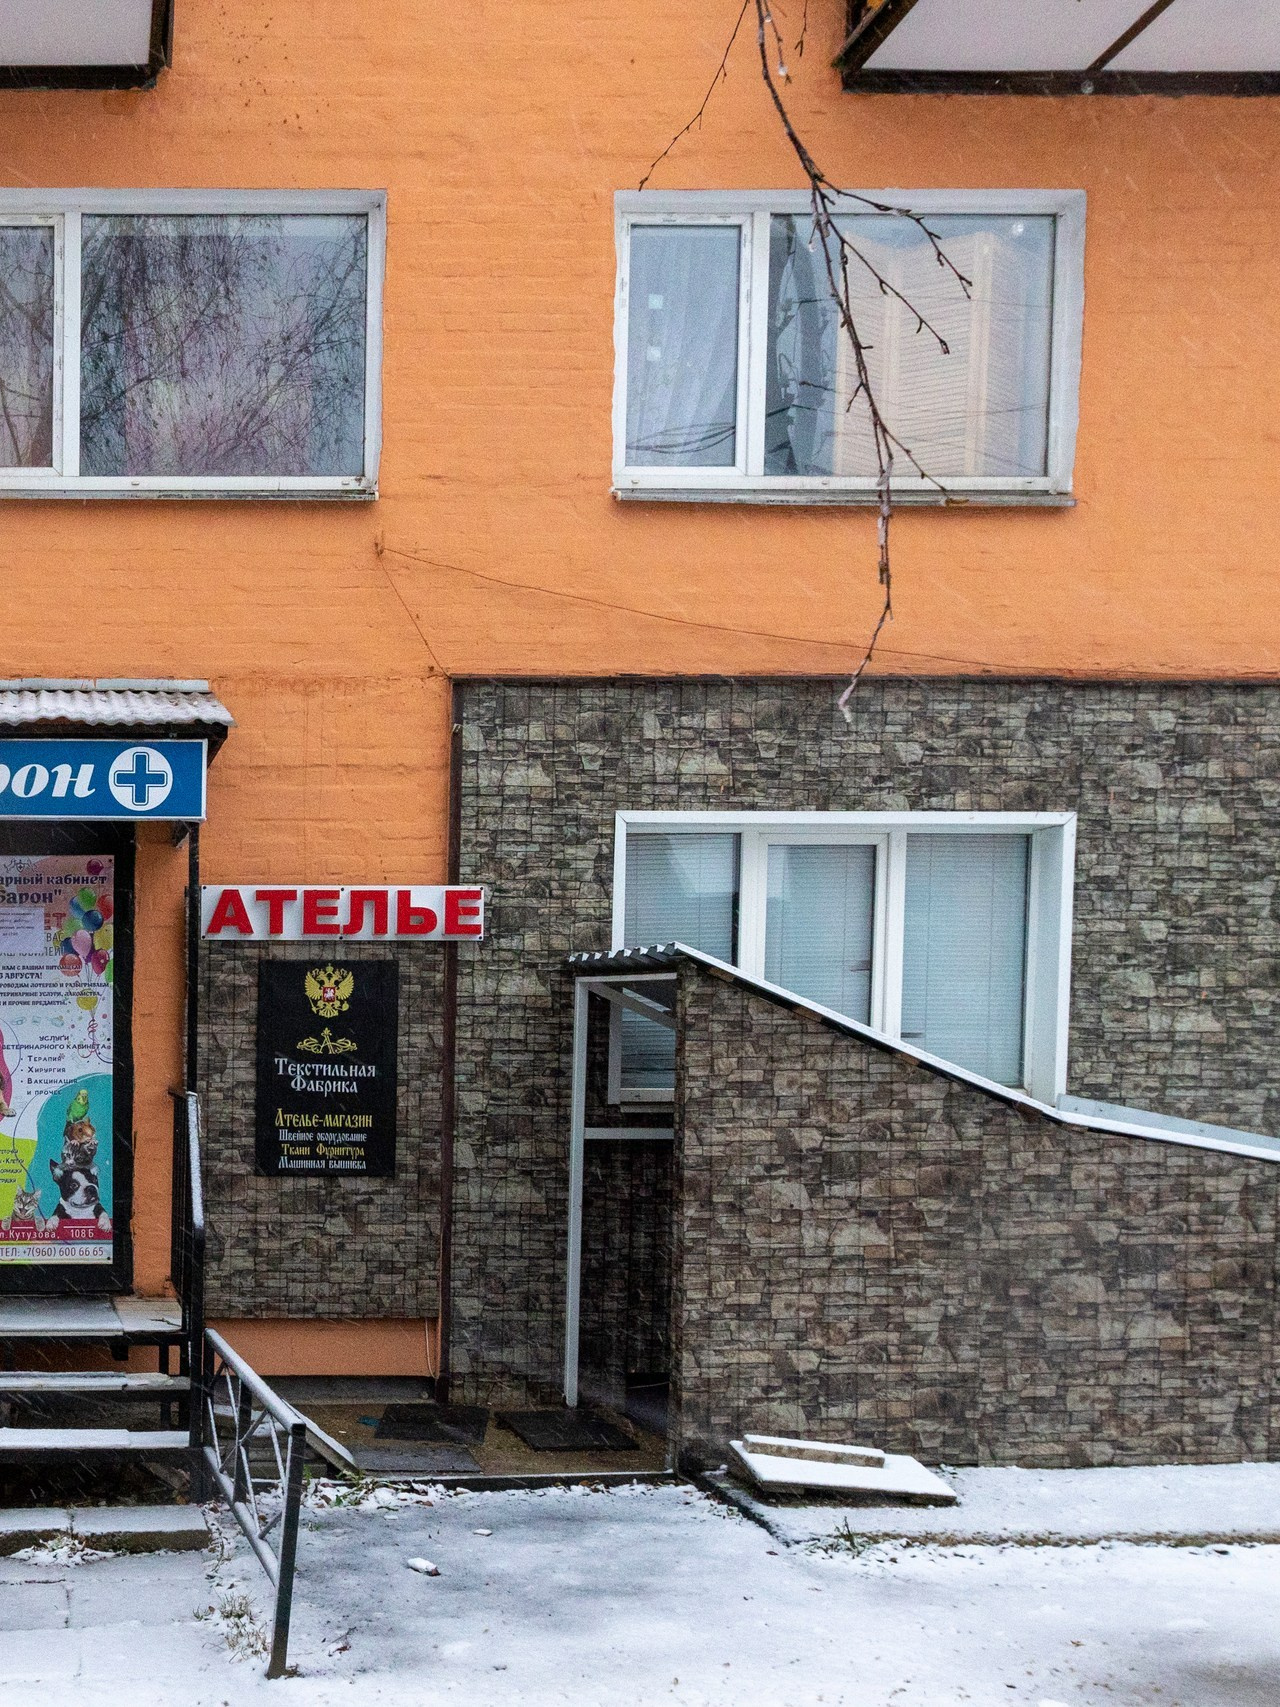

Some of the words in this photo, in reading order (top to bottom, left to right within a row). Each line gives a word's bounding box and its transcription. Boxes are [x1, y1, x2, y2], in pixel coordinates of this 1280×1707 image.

[46, 873, 108, 885] кабинет
[206, 889, 482, 936] АТЕЛЬЕ
[46, 932, 64, 942] ВАС
[5, 972, 43, 980] АВГУСТА!
[275, 1058, 376, 1077] Текстильная
[290, 1075, 358, 1097] Фабрика
[275, 1108, 373, 1128] Ателье-магазин
[279, 1129, 314, 1141] Швейное
[316, 1132, 368, 1145] оборудование
[282, 1143, 310, 1156] Ткани
[316, 1143, 365, 1159] Фурнитура
[278, 1156, 325, 1169] Машинная
[328, 1160, 366, 1170] вышивка
[0, 1248, 20, 1257] ТЕЛ:
[23, 1247, 56, 1257] +7(960)
[60, 1247, 76, 1257] 600
[79, 1246, 90, 1256] 66
[93, 1246, 104, 1256] 65
